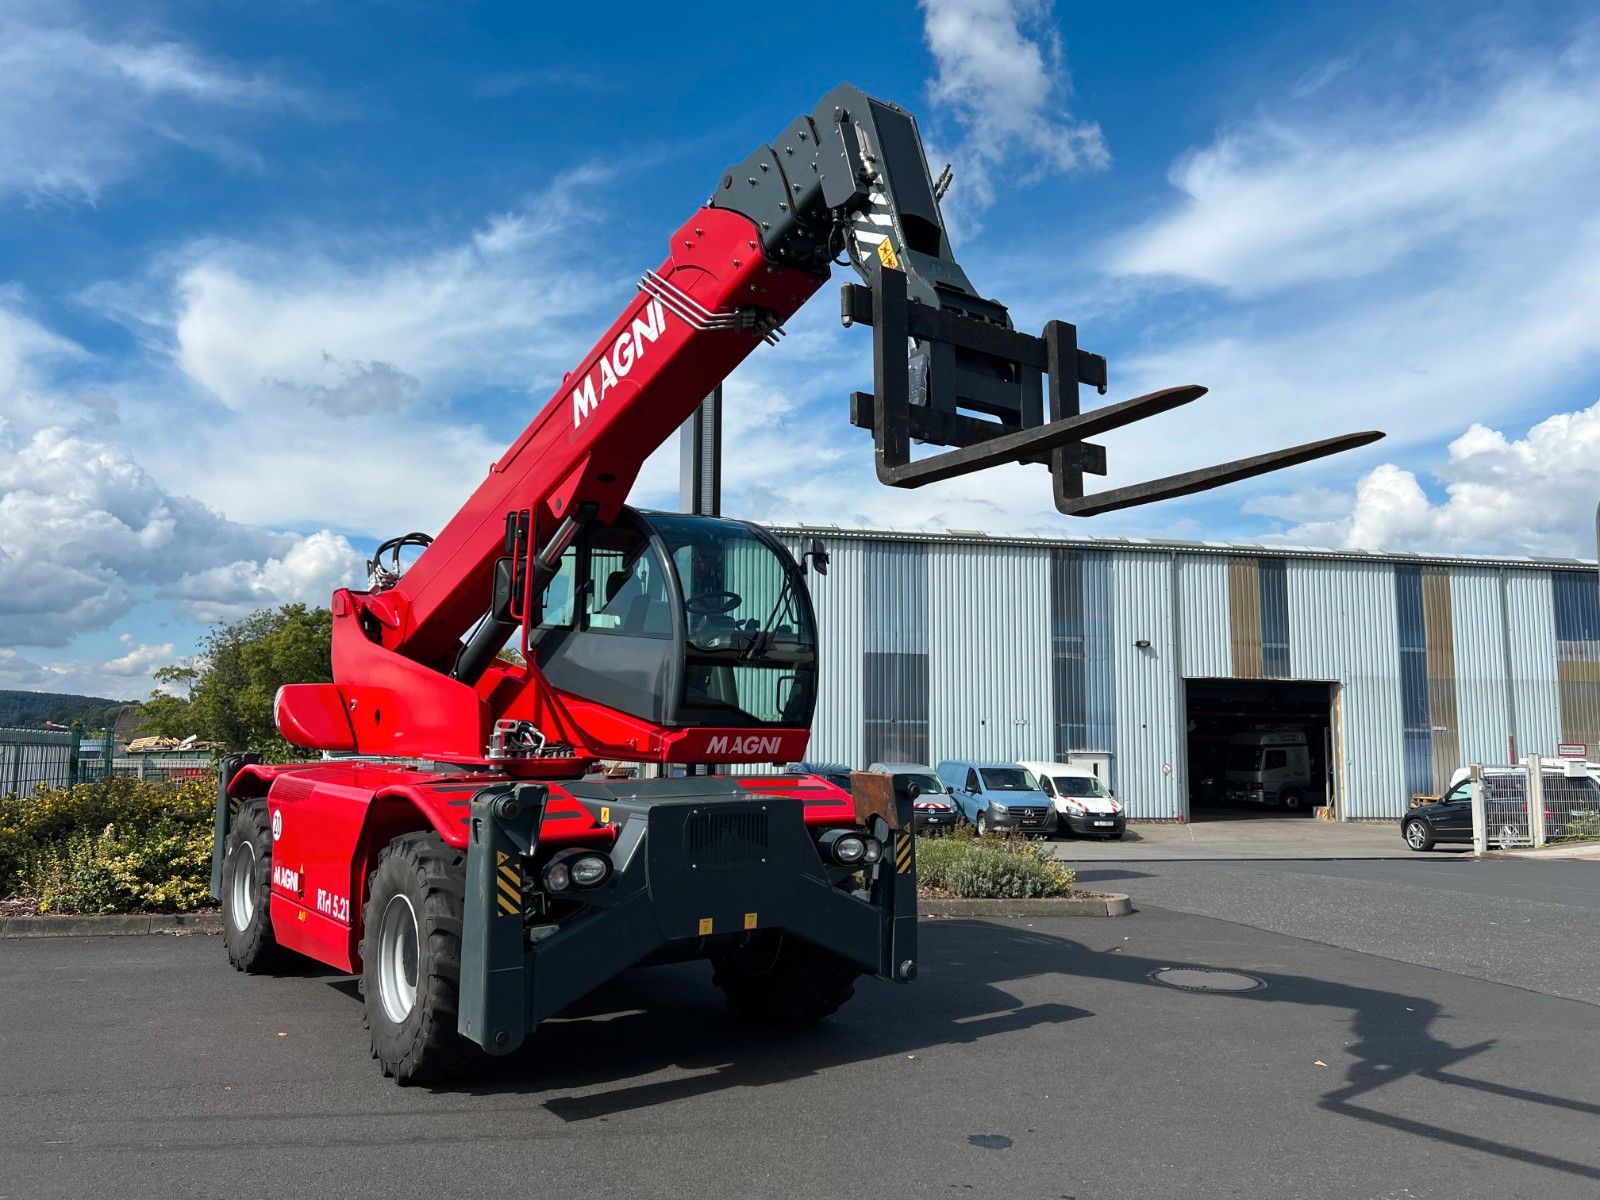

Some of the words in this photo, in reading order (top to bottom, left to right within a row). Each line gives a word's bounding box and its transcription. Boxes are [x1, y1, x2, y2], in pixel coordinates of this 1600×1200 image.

[573, 294, 666, 429] MAGNI
[705, 735, 782, 755] MAGNI
[273, 865, 299, 892] MAGNI
[333, 895, 350, 922] 5.21
